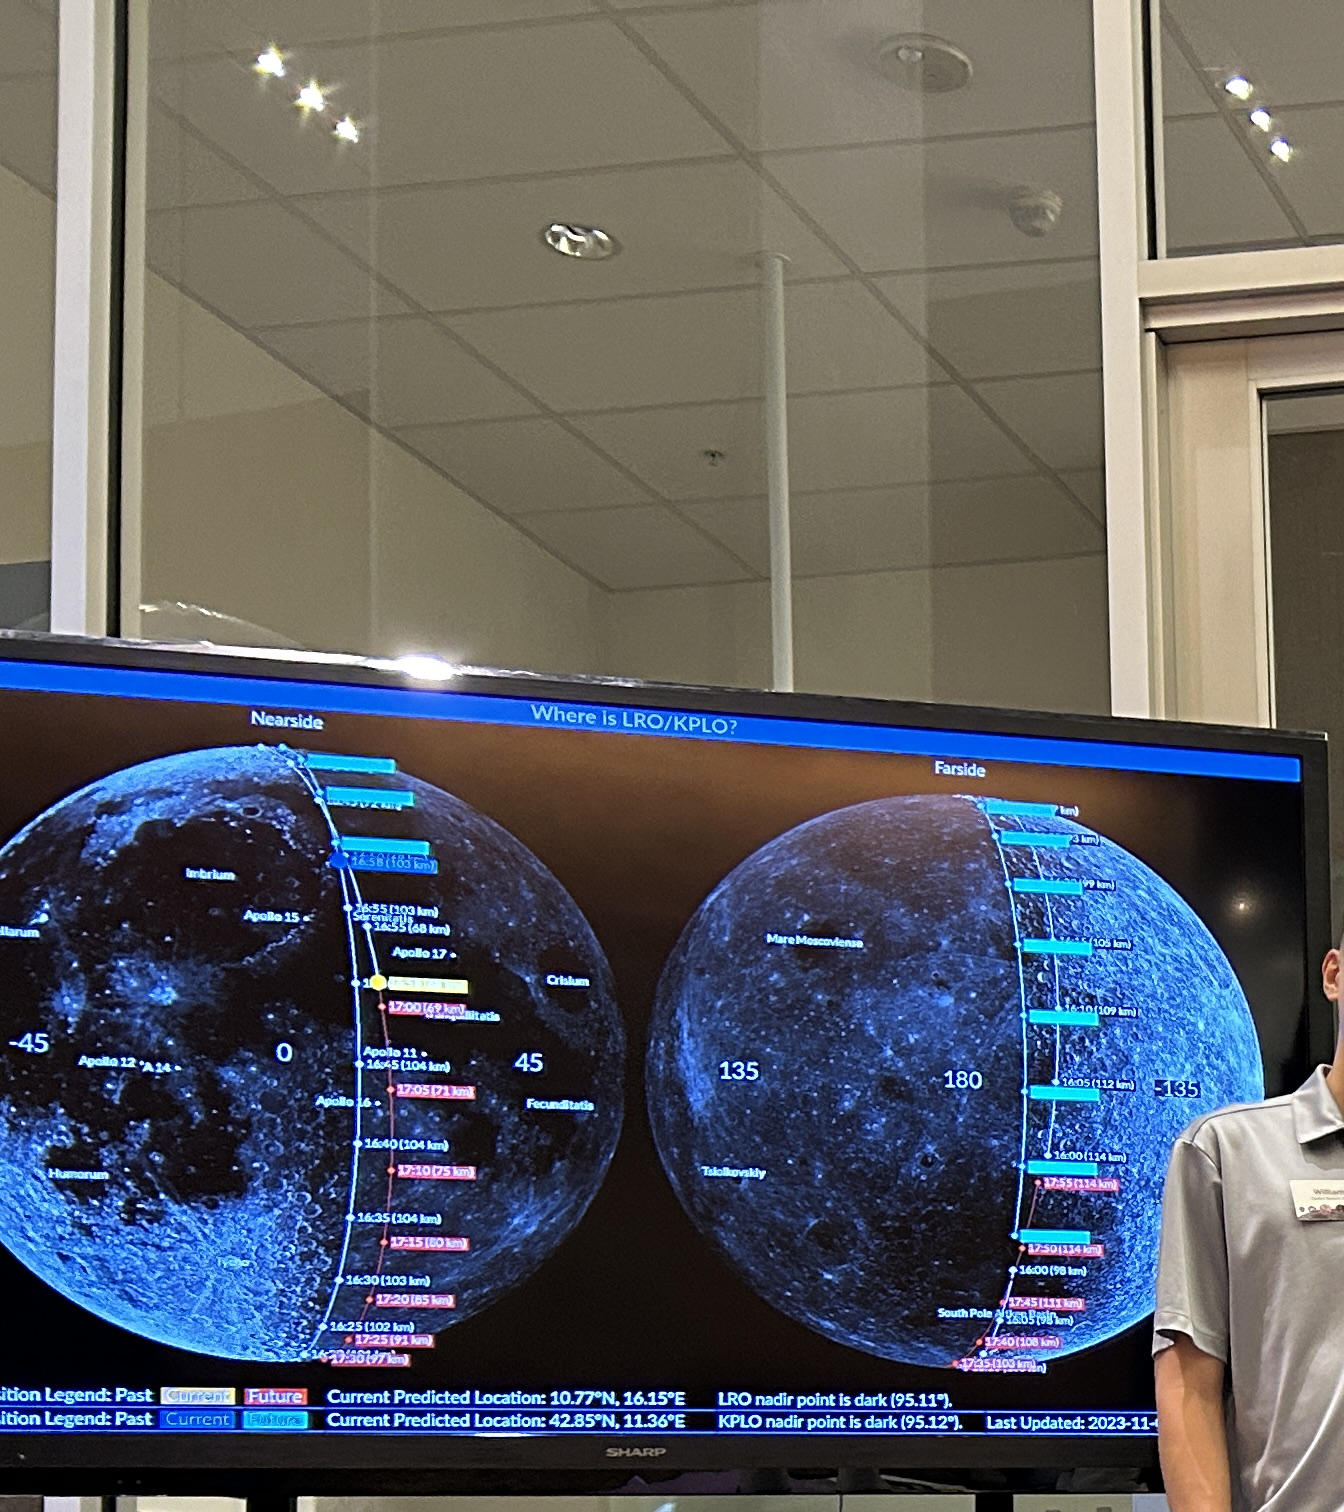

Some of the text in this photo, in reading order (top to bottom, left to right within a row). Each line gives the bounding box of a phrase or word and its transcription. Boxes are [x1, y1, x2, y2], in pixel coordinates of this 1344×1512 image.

[251, 711, 324, 730] Nearside
[530, 704, 737, 735] Where is LRO/KPLO?
[935, 761, 986, 778] Farside
[185, 868, 236, 881] Imbrium
[243, 910, 300, 922] Apollo 15
[766, 933, 794, 945] Mare
[392, 946, 447, 960] Apollo 17
[546, 974, 590, 987] Crisium
[8, 1033, 49, 1054] -45
[275, 1042, 294, 1063] 0
[364, 1046, 417, 1058] Apollo 11
[78, 1055, 136, 1069] Apollo 12
[366, 1060, 450, 1074] 16:45 (104 km)
[514, 1052, 544, 1073] 45
[719, 1061, 983, 1090] 135 180
[1155, 1081, 1198, 1098] -135
[315, 1096, 371, 1108] Apollo 16
[526, 1099, 594, 1112] Fecunditatis
[49, 1168, 109, 1180] Humorum
[358, 1212, 442, 1225] 16:35 (104 km)
[346, 1275, 430, 1287] 16:30 (103 km)
[937, 1308, 993, 1318] South Pole
[330, 1321, 414, 1333] 16:25 (102 km)
[45, 1387, 953, 1410] Legend: Past Current Future Current Predicted Location: 10.77°N, 16.15°E LRO nadir point is dark (95.11°).
[45, 1411, 1159, 1432] Legend: Past Current Future Current Predicted Location: 42.85°N, 11.36°E KPLO nadir point is dark (95.12°). Last Updated: 2023-11-
[605, 1447, 666, 1458] SHARP
